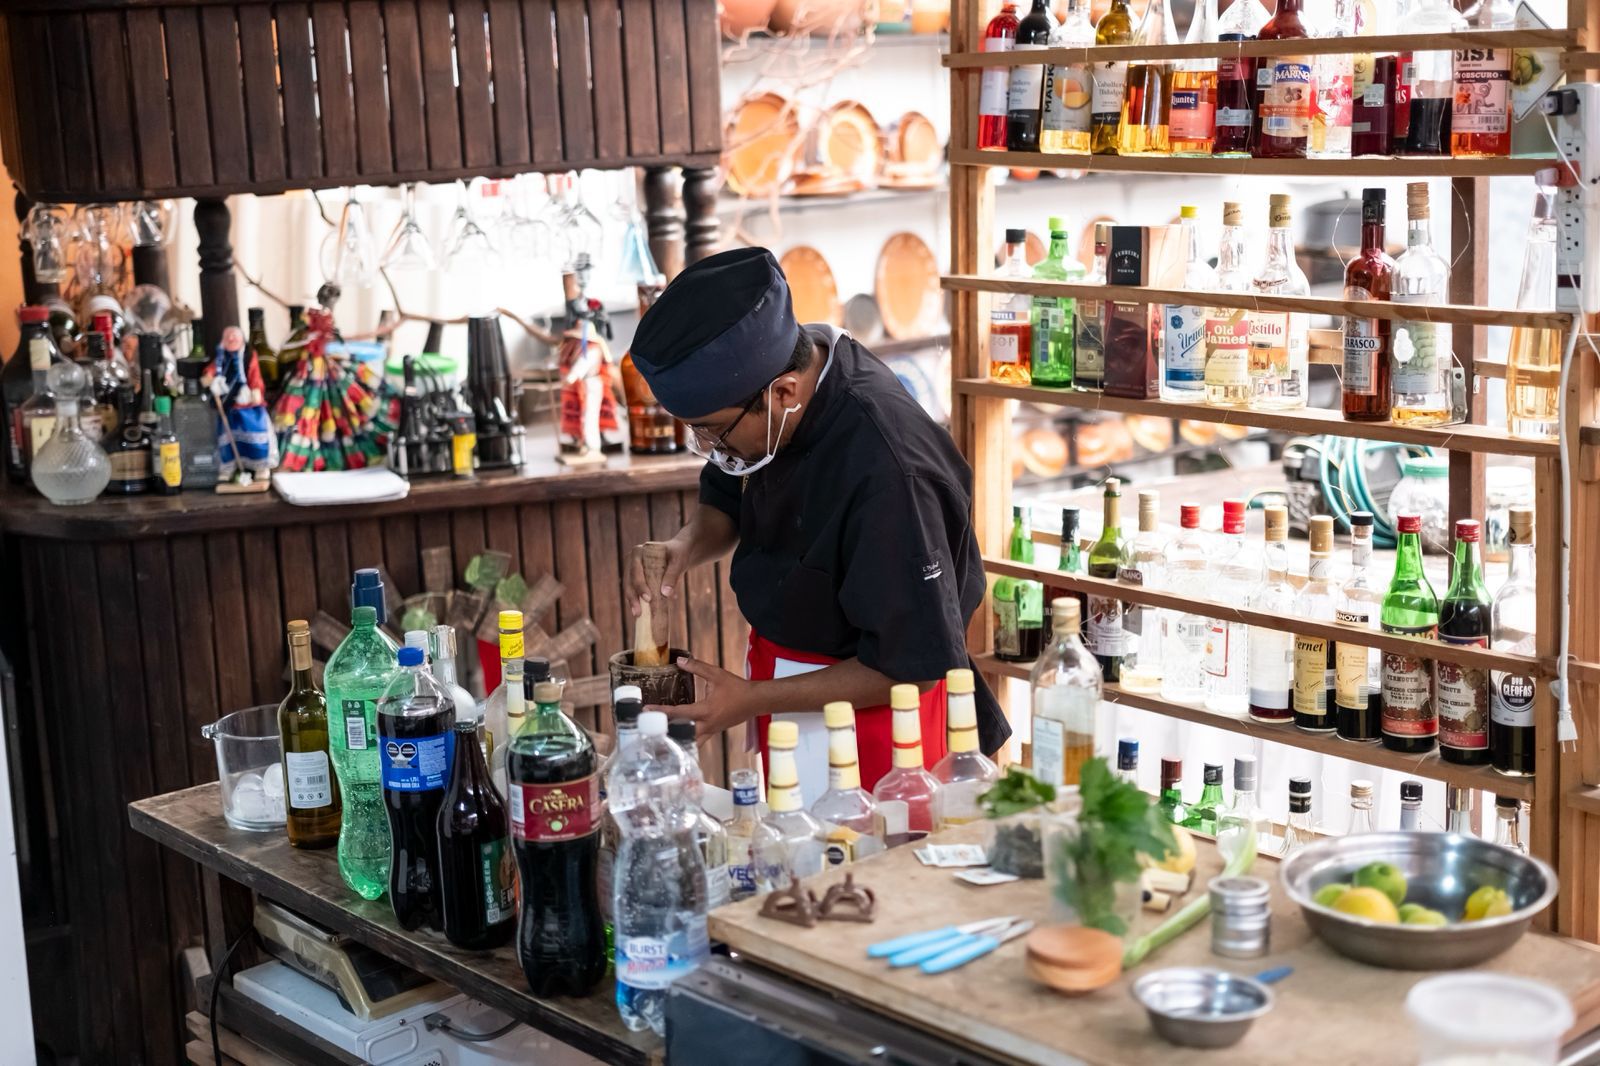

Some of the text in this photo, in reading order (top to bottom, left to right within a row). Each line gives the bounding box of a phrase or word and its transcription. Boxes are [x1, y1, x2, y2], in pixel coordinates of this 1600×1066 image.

[1214, 324, 1234, 336] Old
[1206, 331, 1247, 345] James
[1503, 684, 1532, 697] CLEOFAS
[529, 794, 584, 815] CASERA
[629, 943, 664, 955] BURST
